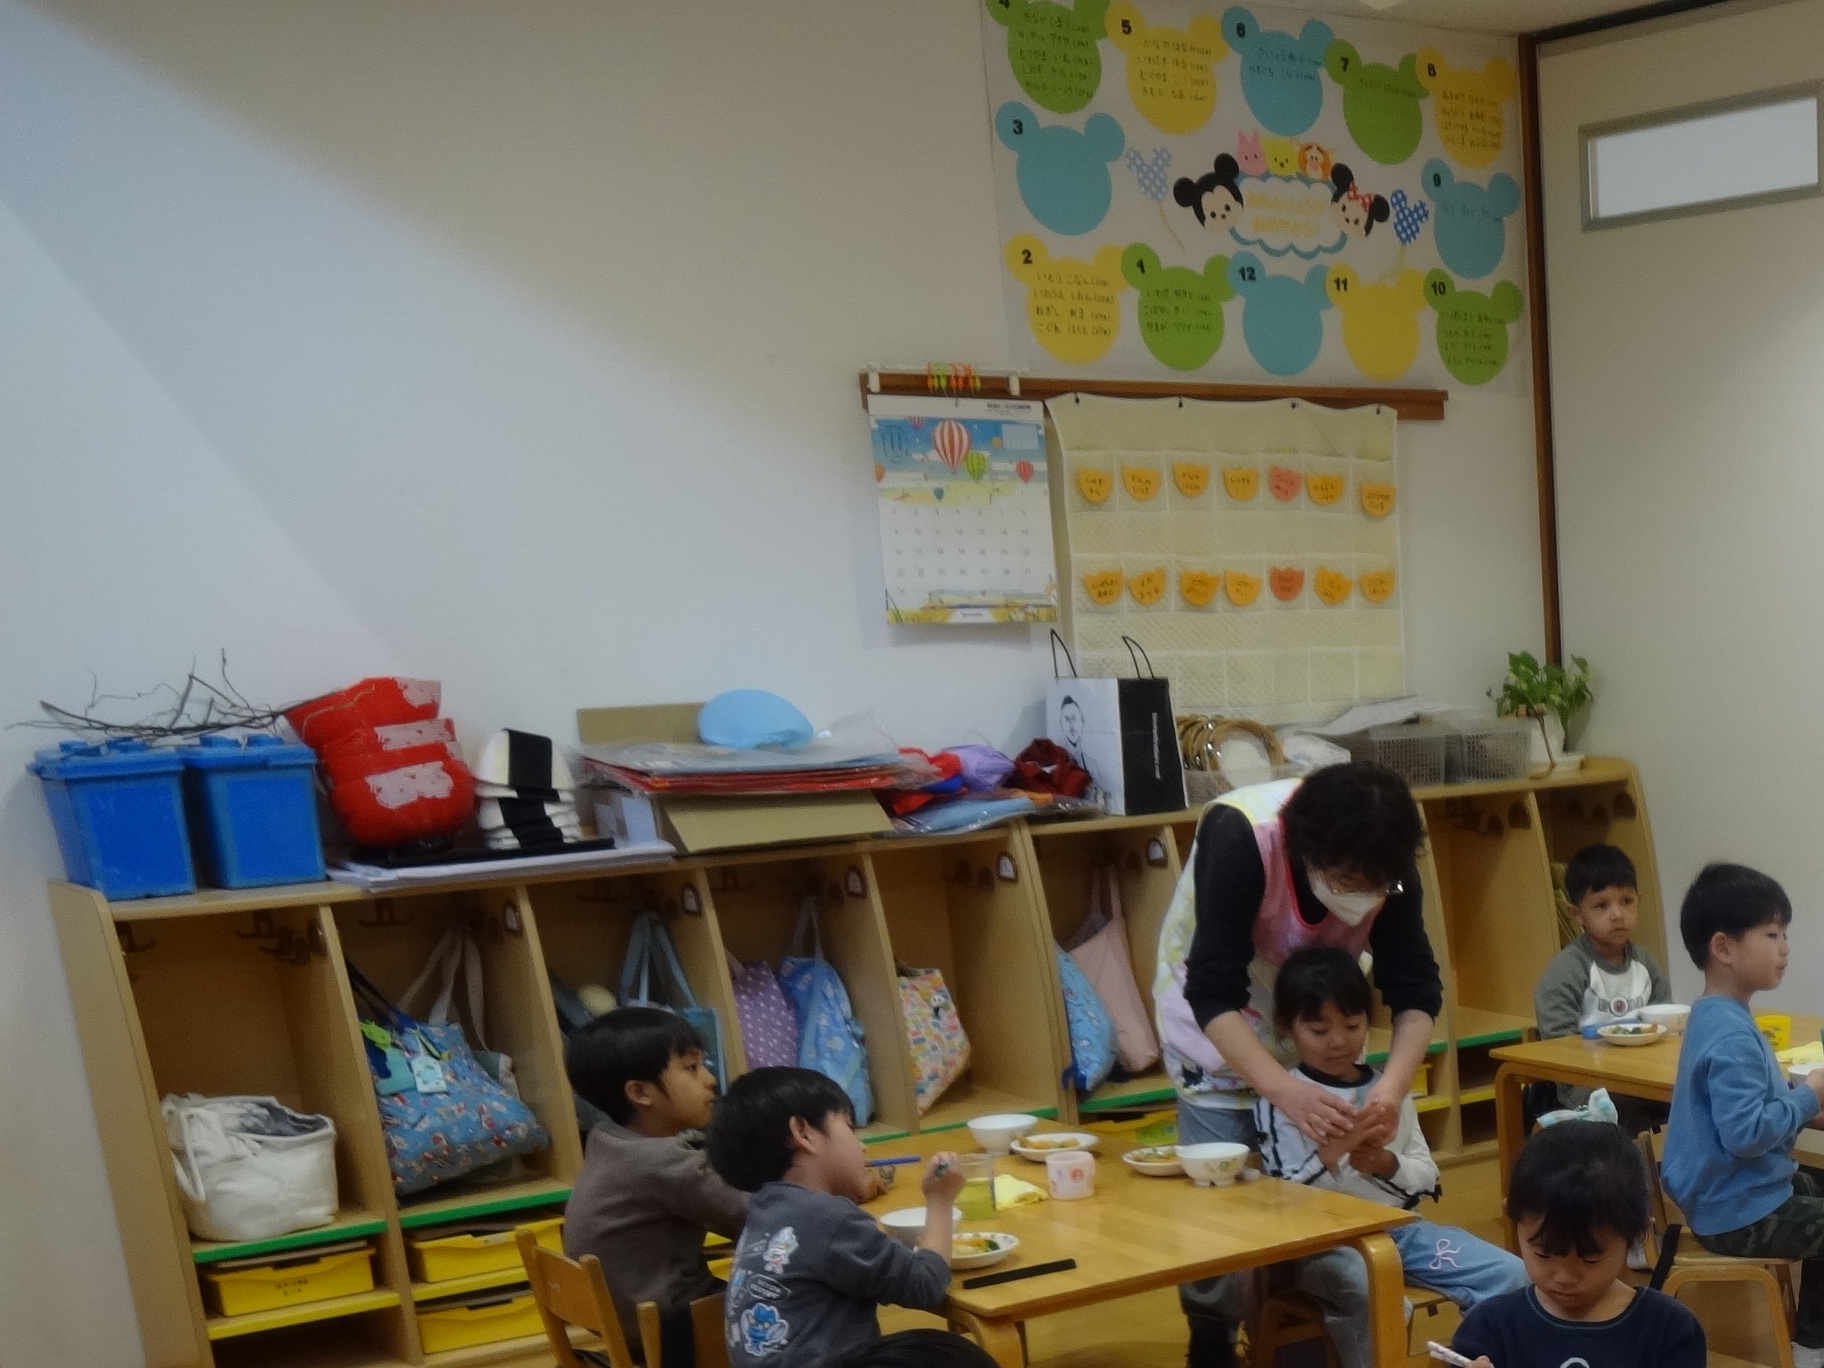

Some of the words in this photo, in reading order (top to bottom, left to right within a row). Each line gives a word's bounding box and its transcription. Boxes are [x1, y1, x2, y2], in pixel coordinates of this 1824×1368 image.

[1121, 18, 1132, 35] 5
[1236, 22, 1246, 38] 6
[1340, 57, 1350, 72] 7
[1427, 62, 1437, 77] 8
[1012, 119, 1024, 135] 3
[1432, 173, 1442, 188] 9
[1021, 249, 1033, 265] 2
[1136, 259, 1146, 274] 1
[1238, 266, 1257, 281] 12
[1334, 277, 1348, 292] 11
[1431, 281, 1446, 296] 10
